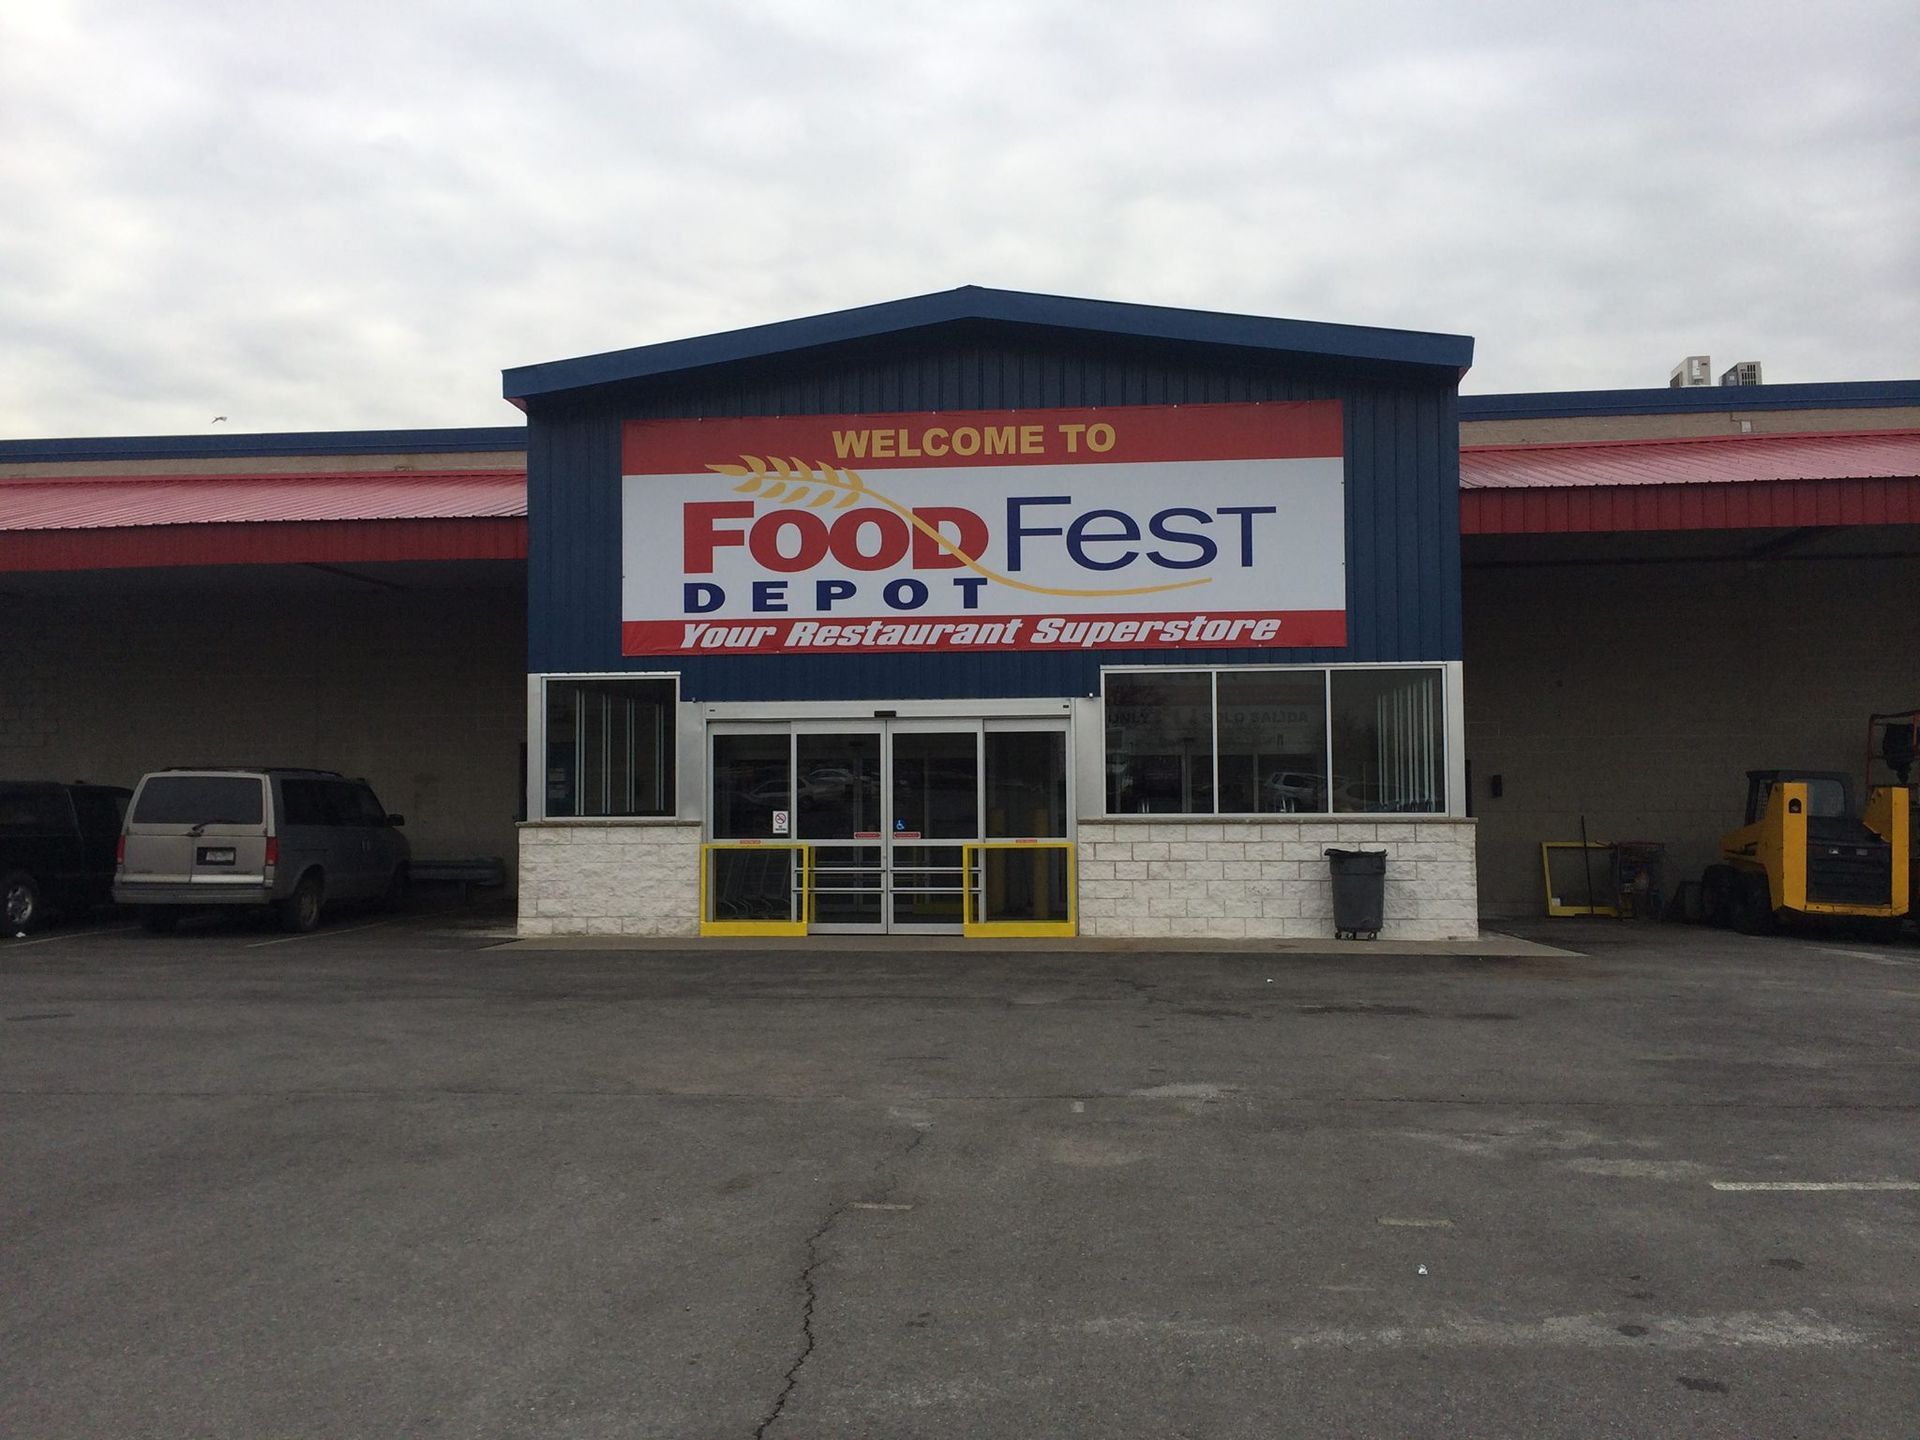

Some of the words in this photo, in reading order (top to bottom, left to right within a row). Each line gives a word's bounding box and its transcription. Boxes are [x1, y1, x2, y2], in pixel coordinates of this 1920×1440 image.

[832, 426, 1045, 459] WELCOME
[1058, 423, 1116, 453] TO
[684, 501, 989, 574] FOOD
[683, 577, 988, 613] DEPOT
[680, 623, 777, 649] Your
[783, 618, 1023, 647] Restaurant
[1030, 615, 1282, 647] Superstore
